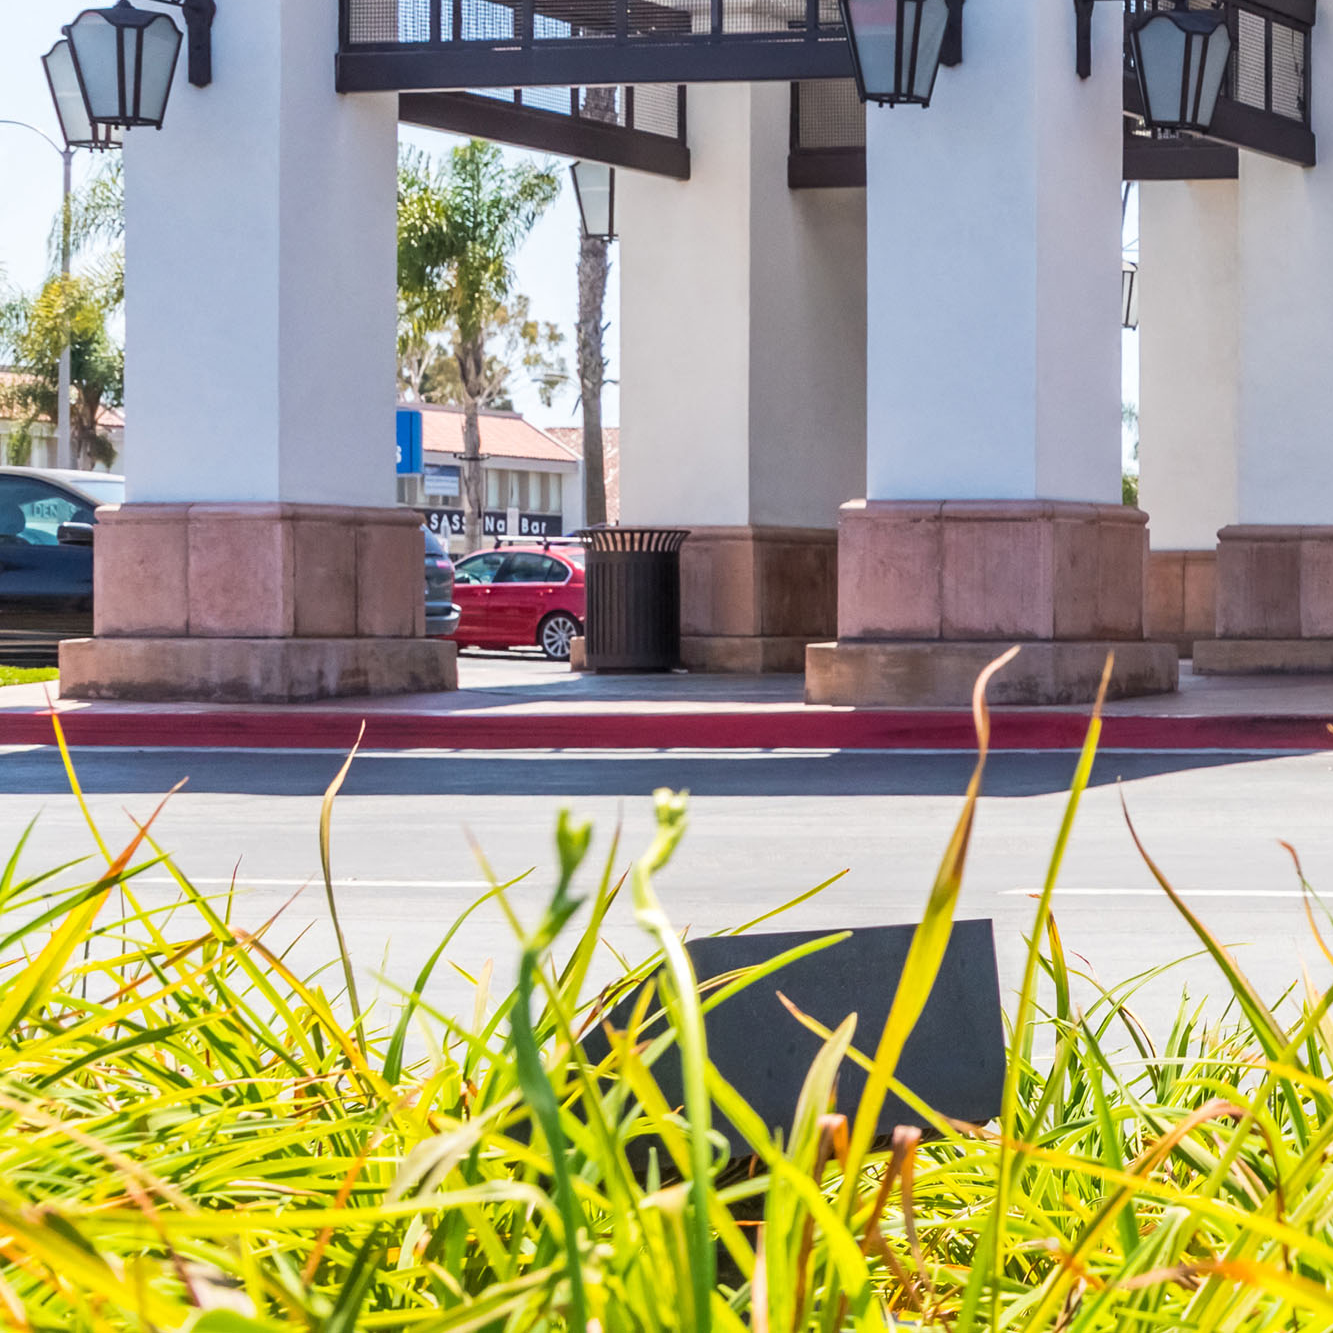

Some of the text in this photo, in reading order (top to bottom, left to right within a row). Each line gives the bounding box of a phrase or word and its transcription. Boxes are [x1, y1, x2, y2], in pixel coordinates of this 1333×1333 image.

[430, 513, 547, 534] SASS Na Bar
